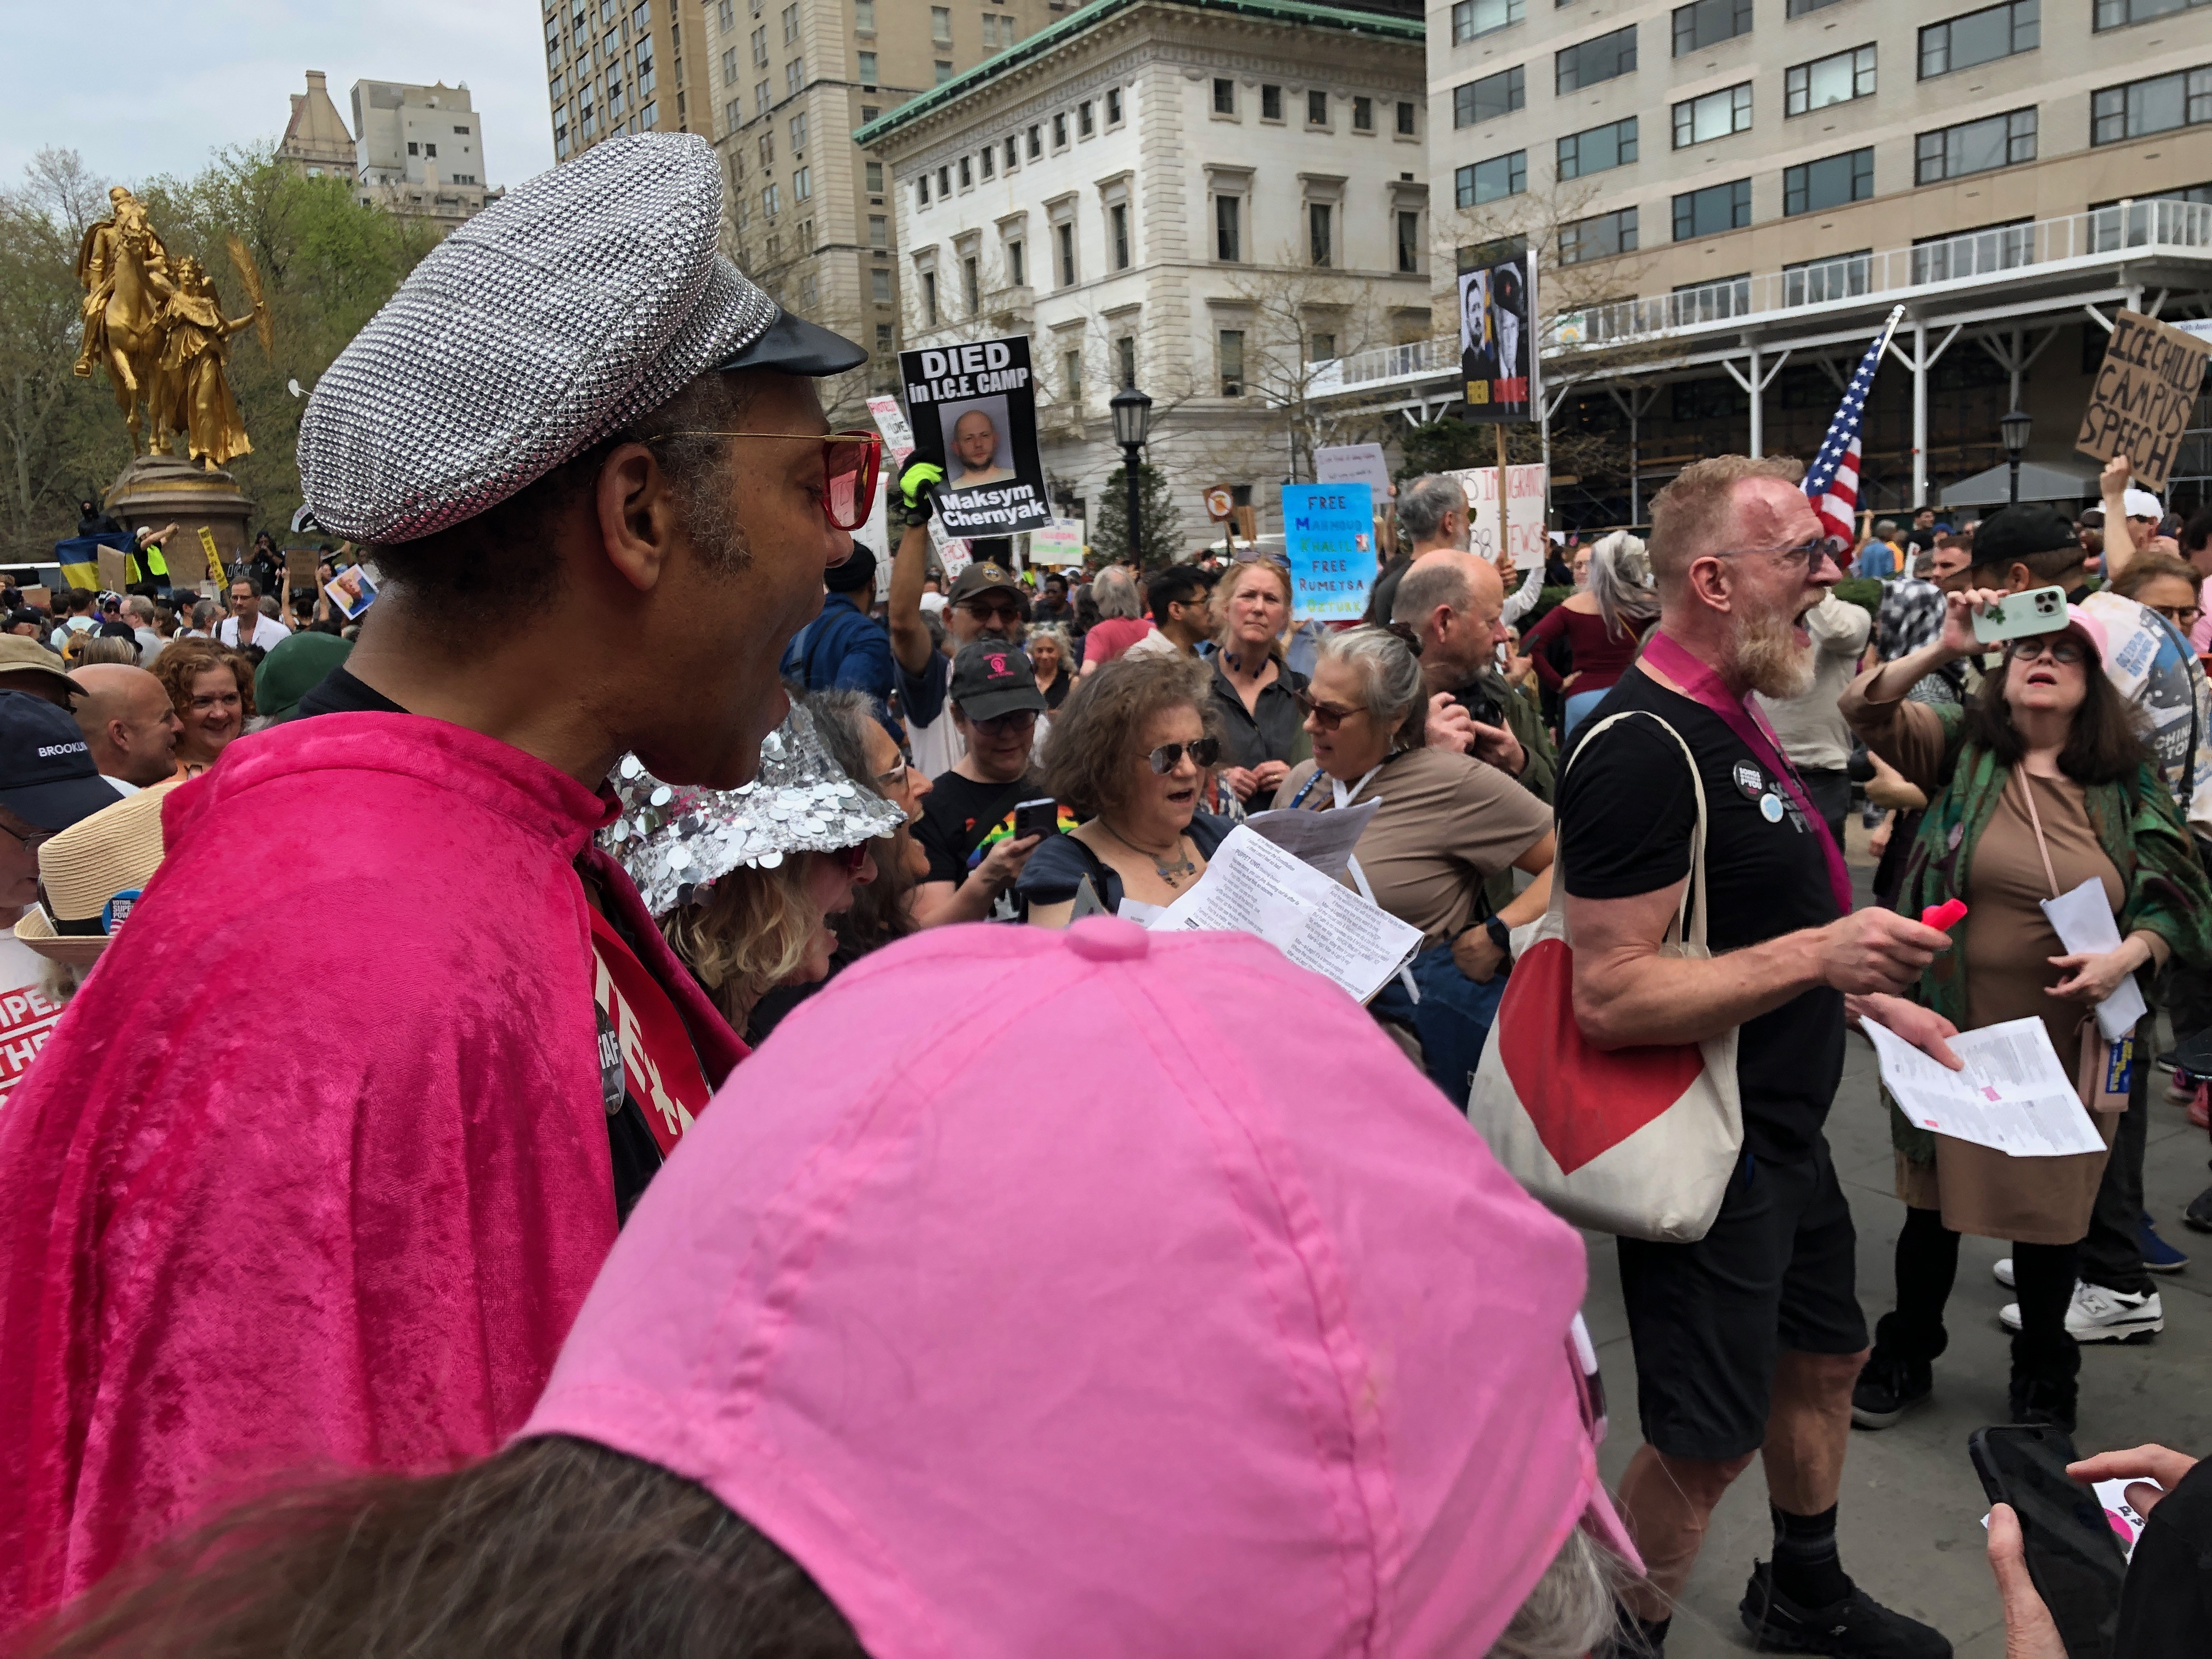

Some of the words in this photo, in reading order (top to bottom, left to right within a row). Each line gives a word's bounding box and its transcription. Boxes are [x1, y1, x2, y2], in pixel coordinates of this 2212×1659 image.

[2108, 318, 2156, 369] ICE
[921, 342, 1011, 379] DIED
[908, 383, 930, 403] in
[932, 376, 975, 400] I.C.E.
[977, 367, 1029, 394] CAMP
[2096, 364, 2193, 439] CAMPUS
[2080, 402, 2172, 482] SPEECH
[940, 484, 1034, 511] Maksym
[1307, 496, 1347, 510] FREE
[941, 500, 1047, 527] Chernyak
[1300, 537, 1352, 552] KHALIL
[1507, 521, 1542, 556] EWS
[1312, 560, 1346, 573] FREE
[1299, 577, 1364, 591] RUMEYSA
[38, 742, 88, 757] BROOKL
[2154, 723, 2192, 750] CHIN
[1234, 848, 1250, 862] PUPPET
[1248, 859, 1261, 869] KING
